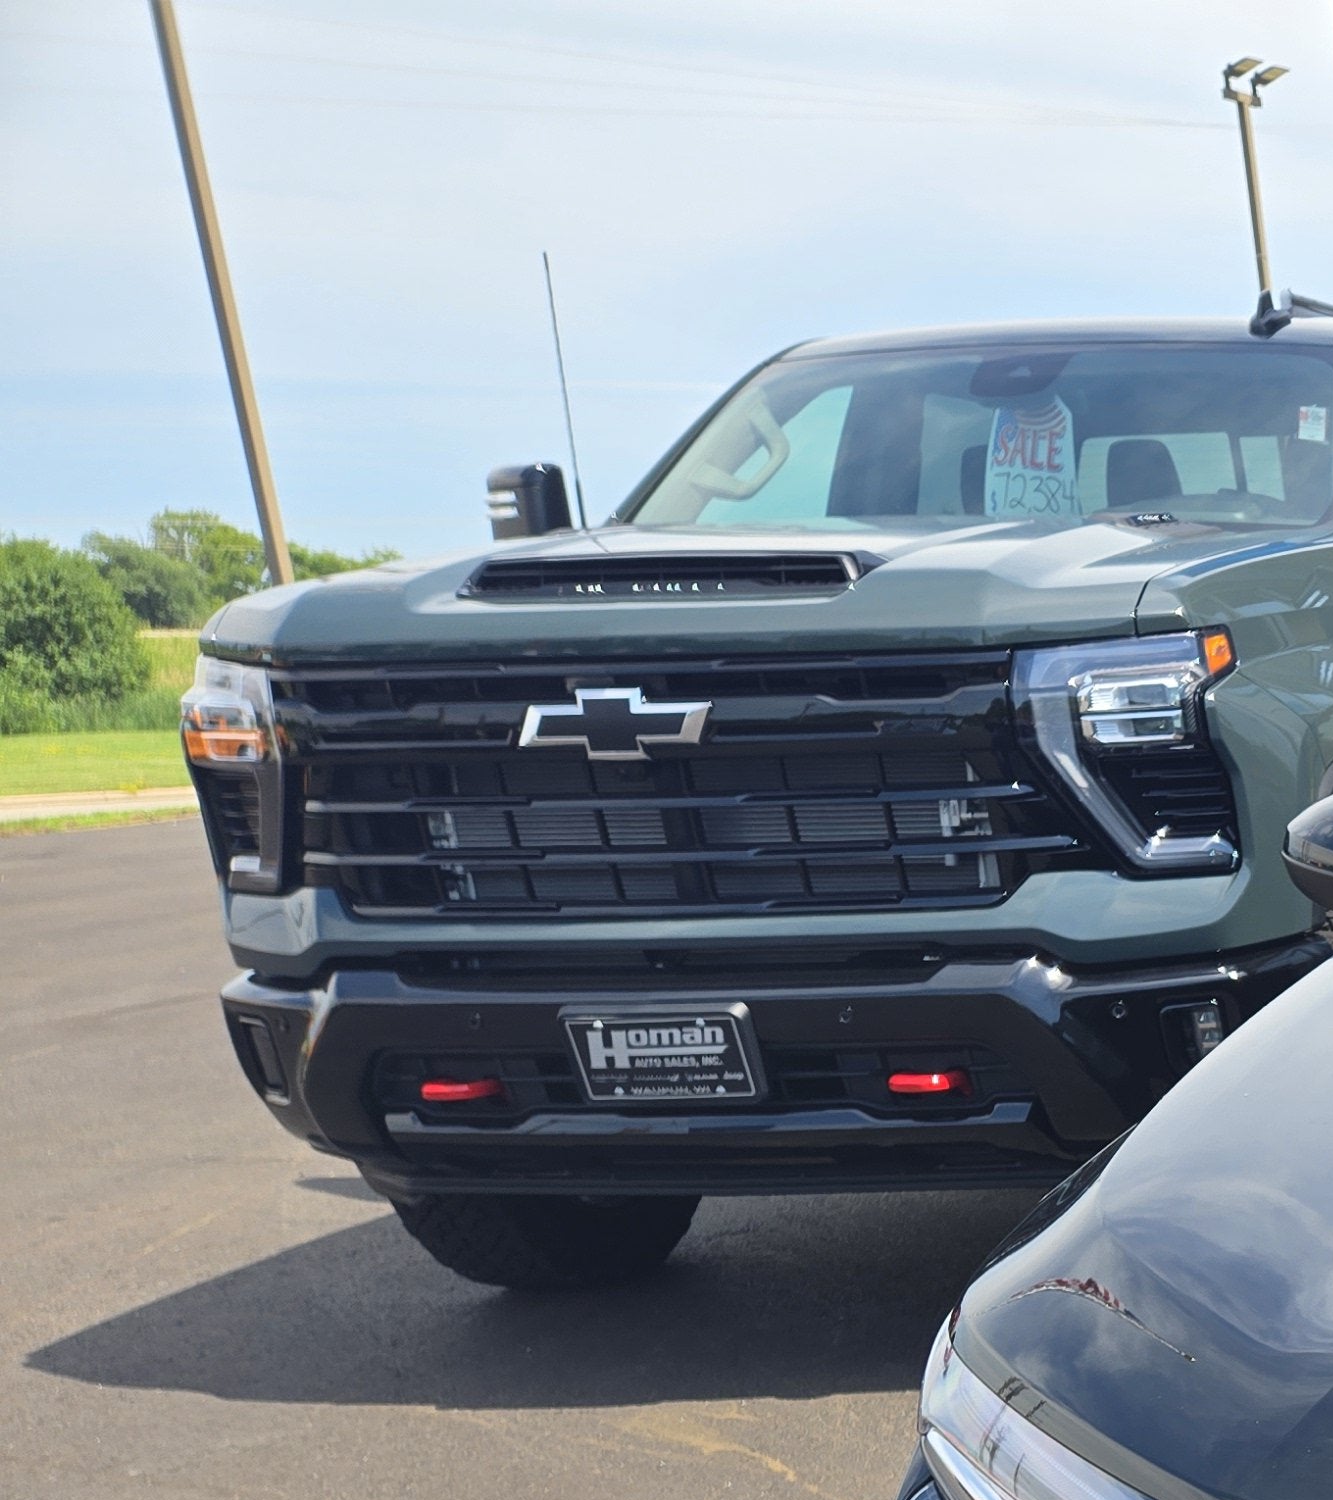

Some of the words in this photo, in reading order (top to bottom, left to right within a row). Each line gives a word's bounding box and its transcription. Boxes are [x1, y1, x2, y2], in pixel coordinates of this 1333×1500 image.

[992, 425, 1067, 473] SALE
[586, 1026, 728, 1069] Homan
[634, 1057, 662, 1068] AUTO
[664, 1056, 700, 1068] SALES,
